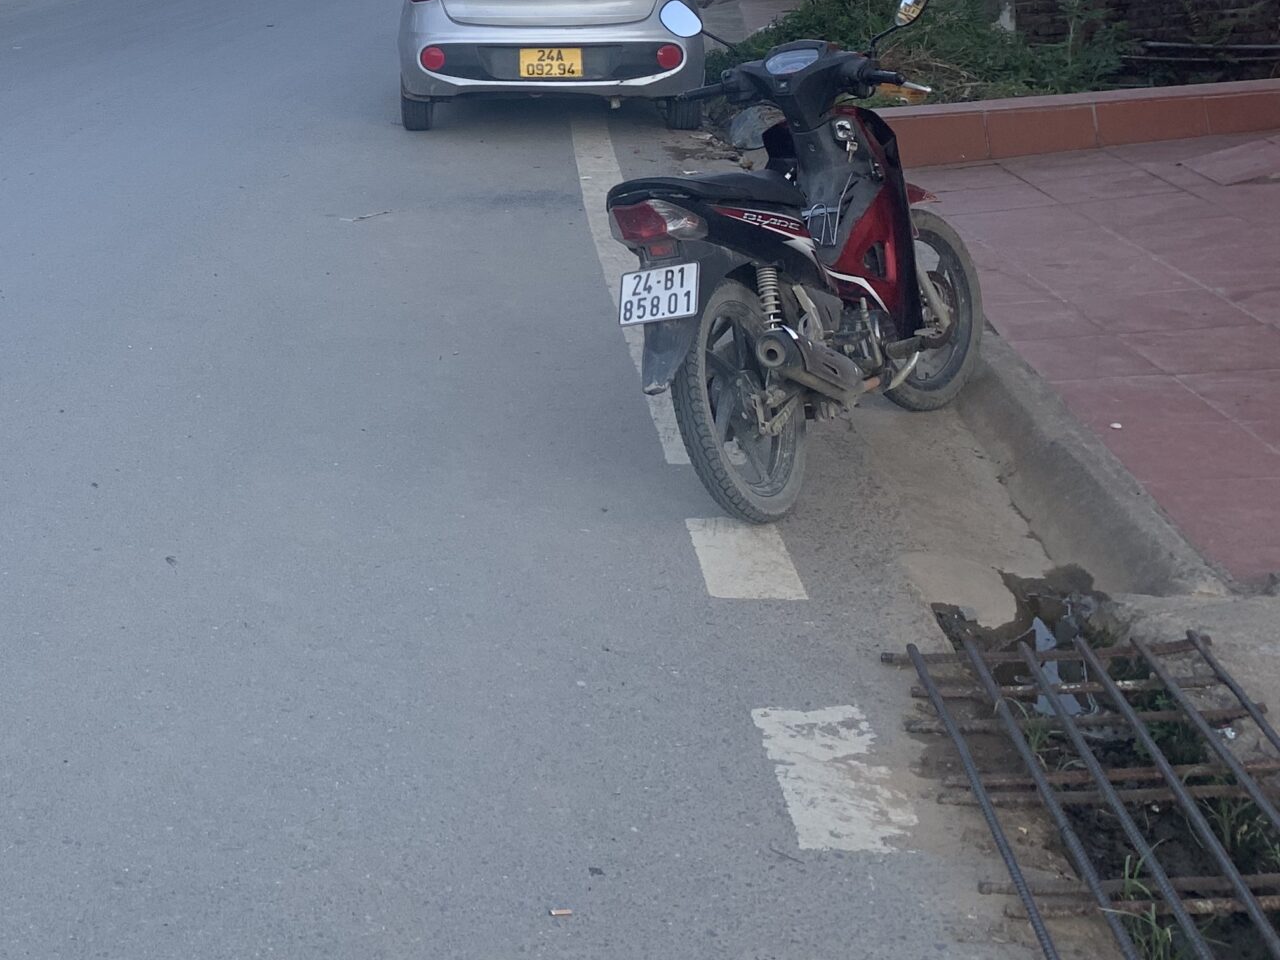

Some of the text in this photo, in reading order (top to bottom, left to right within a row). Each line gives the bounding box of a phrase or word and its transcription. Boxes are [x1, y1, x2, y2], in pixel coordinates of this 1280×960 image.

[537, 49, 564, 62] 24A
[526, 62, 576, 76] 092.94
[743, 212, 801, 231] BLADE
[631, 266, 686, 297] 24-B1
[623, 290, 692, 322] 858.01
